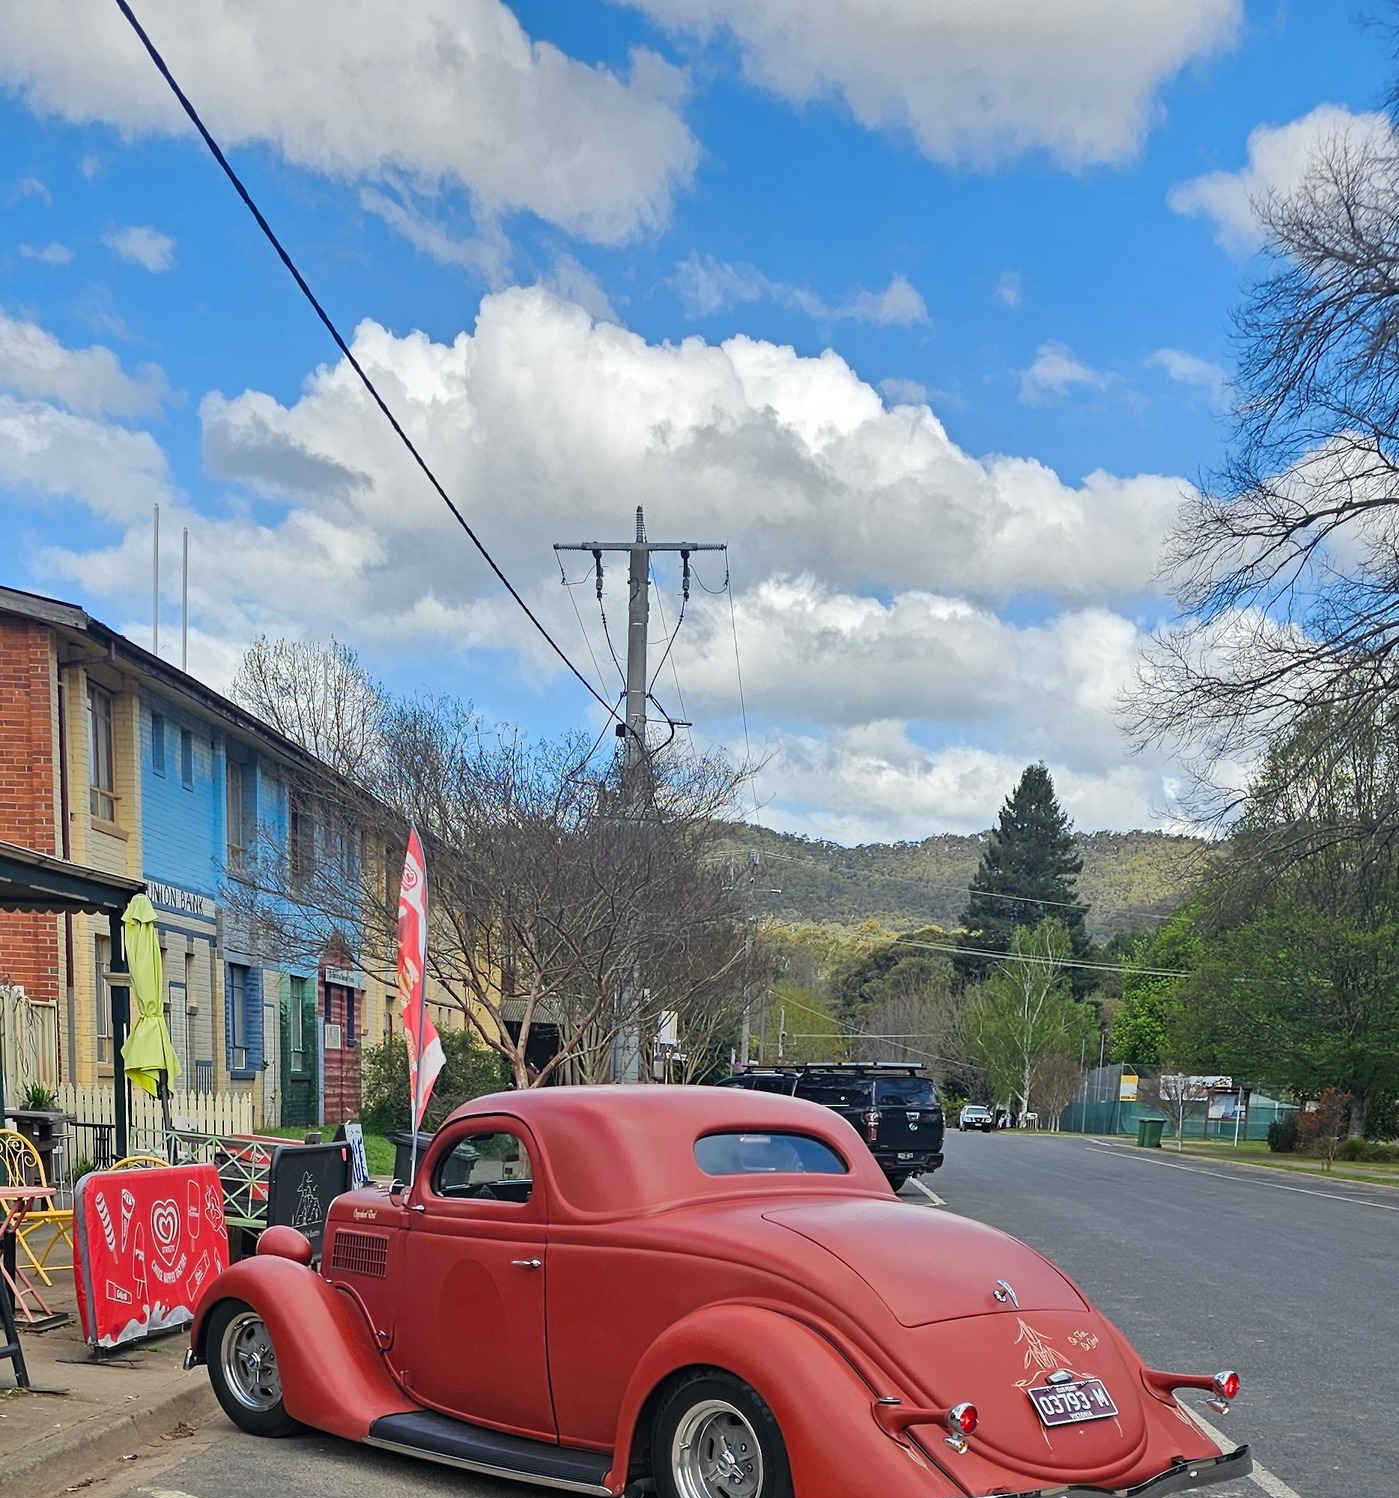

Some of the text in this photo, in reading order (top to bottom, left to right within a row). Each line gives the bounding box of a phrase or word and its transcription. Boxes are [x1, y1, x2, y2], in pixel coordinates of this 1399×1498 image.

[148, 881, 204, 915] UNION BANK
[1069, 1410, 1094, 1420] VICTORIA
